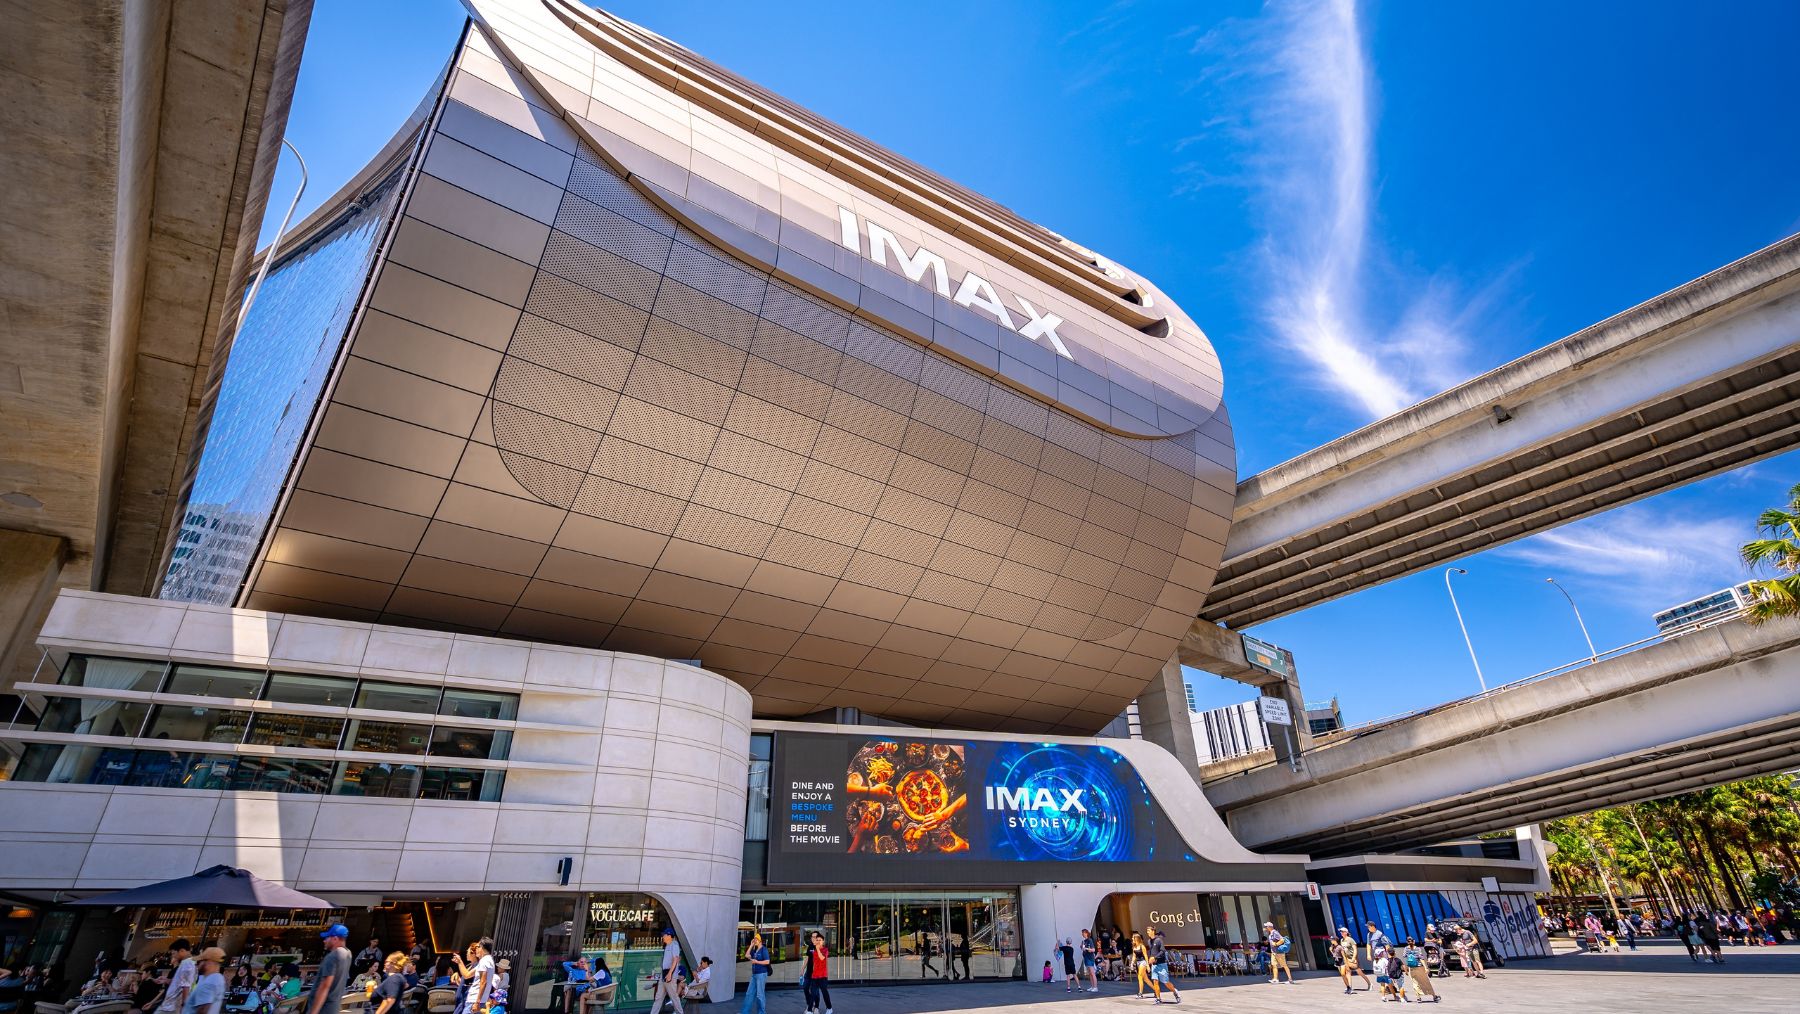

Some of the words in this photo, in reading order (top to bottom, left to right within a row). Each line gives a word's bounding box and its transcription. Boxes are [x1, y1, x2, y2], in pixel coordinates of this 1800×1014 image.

[838, 205, 1075, 360] IMAX
[792, 781, 813, 790] DINE
[814, 782, 834, 790] AND
[791, 792, 823, 800] ENJOY
[824, 793, 832, 801] A
[985, 786, 1088, 813] IMAX
[791, 803, 833, 811] BESPOKE
[791, 813, 817, 821] MENU
[1008, 816, 1071, 828] SYDNEY
[790, 824, 827, 833] BEFORE
[790, 835, 808, 844] THE
[810, 835, 840, 844] MOVIE
[1149, 910, 1185, 928] Gong
